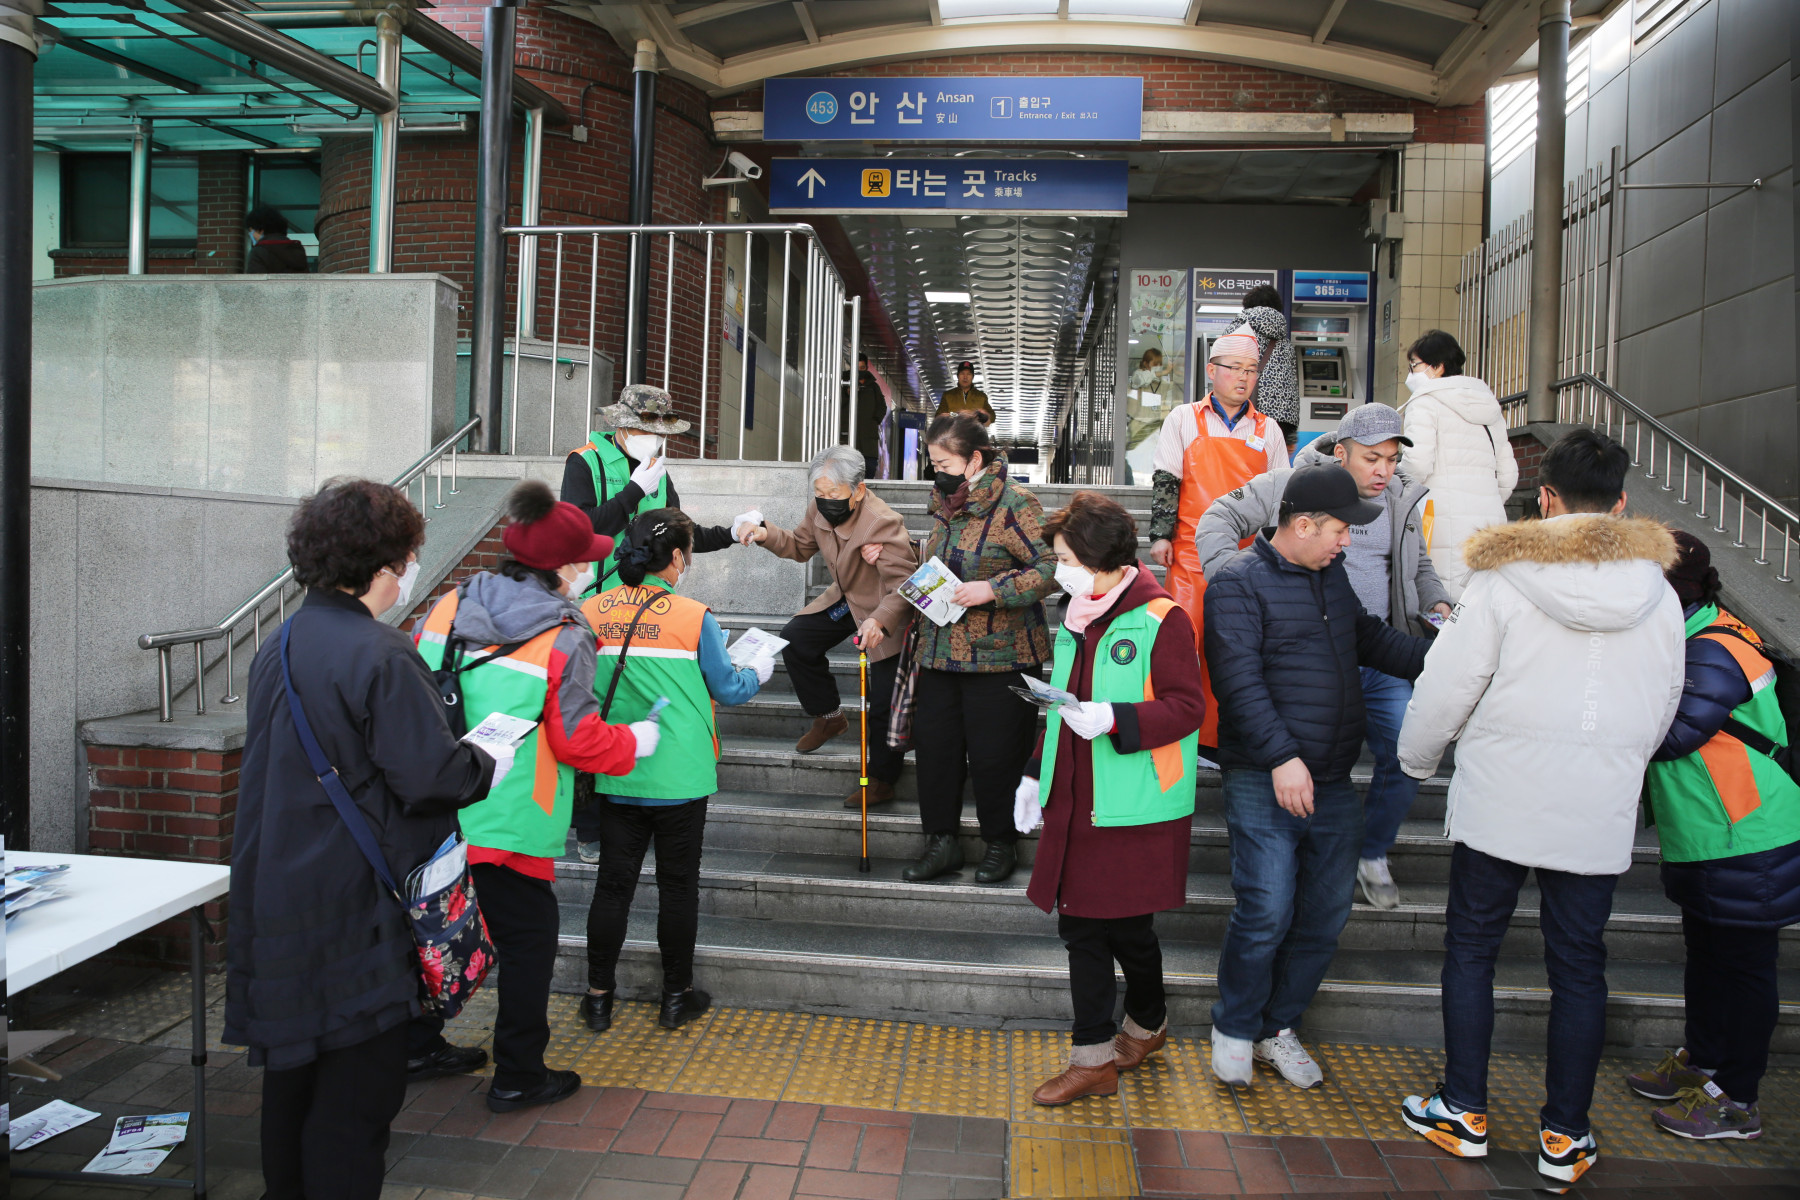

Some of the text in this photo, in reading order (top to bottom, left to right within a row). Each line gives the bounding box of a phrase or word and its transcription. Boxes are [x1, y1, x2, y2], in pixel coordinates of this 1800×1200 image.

[936, 91, 975, 103] Ansan
[1019, 97, 1051, 109] 출입구
[810, 101, 834, 115] 453
[994, 170, 1037, 182] Tracks
[896, 169, 986, 198] 타는 곳
